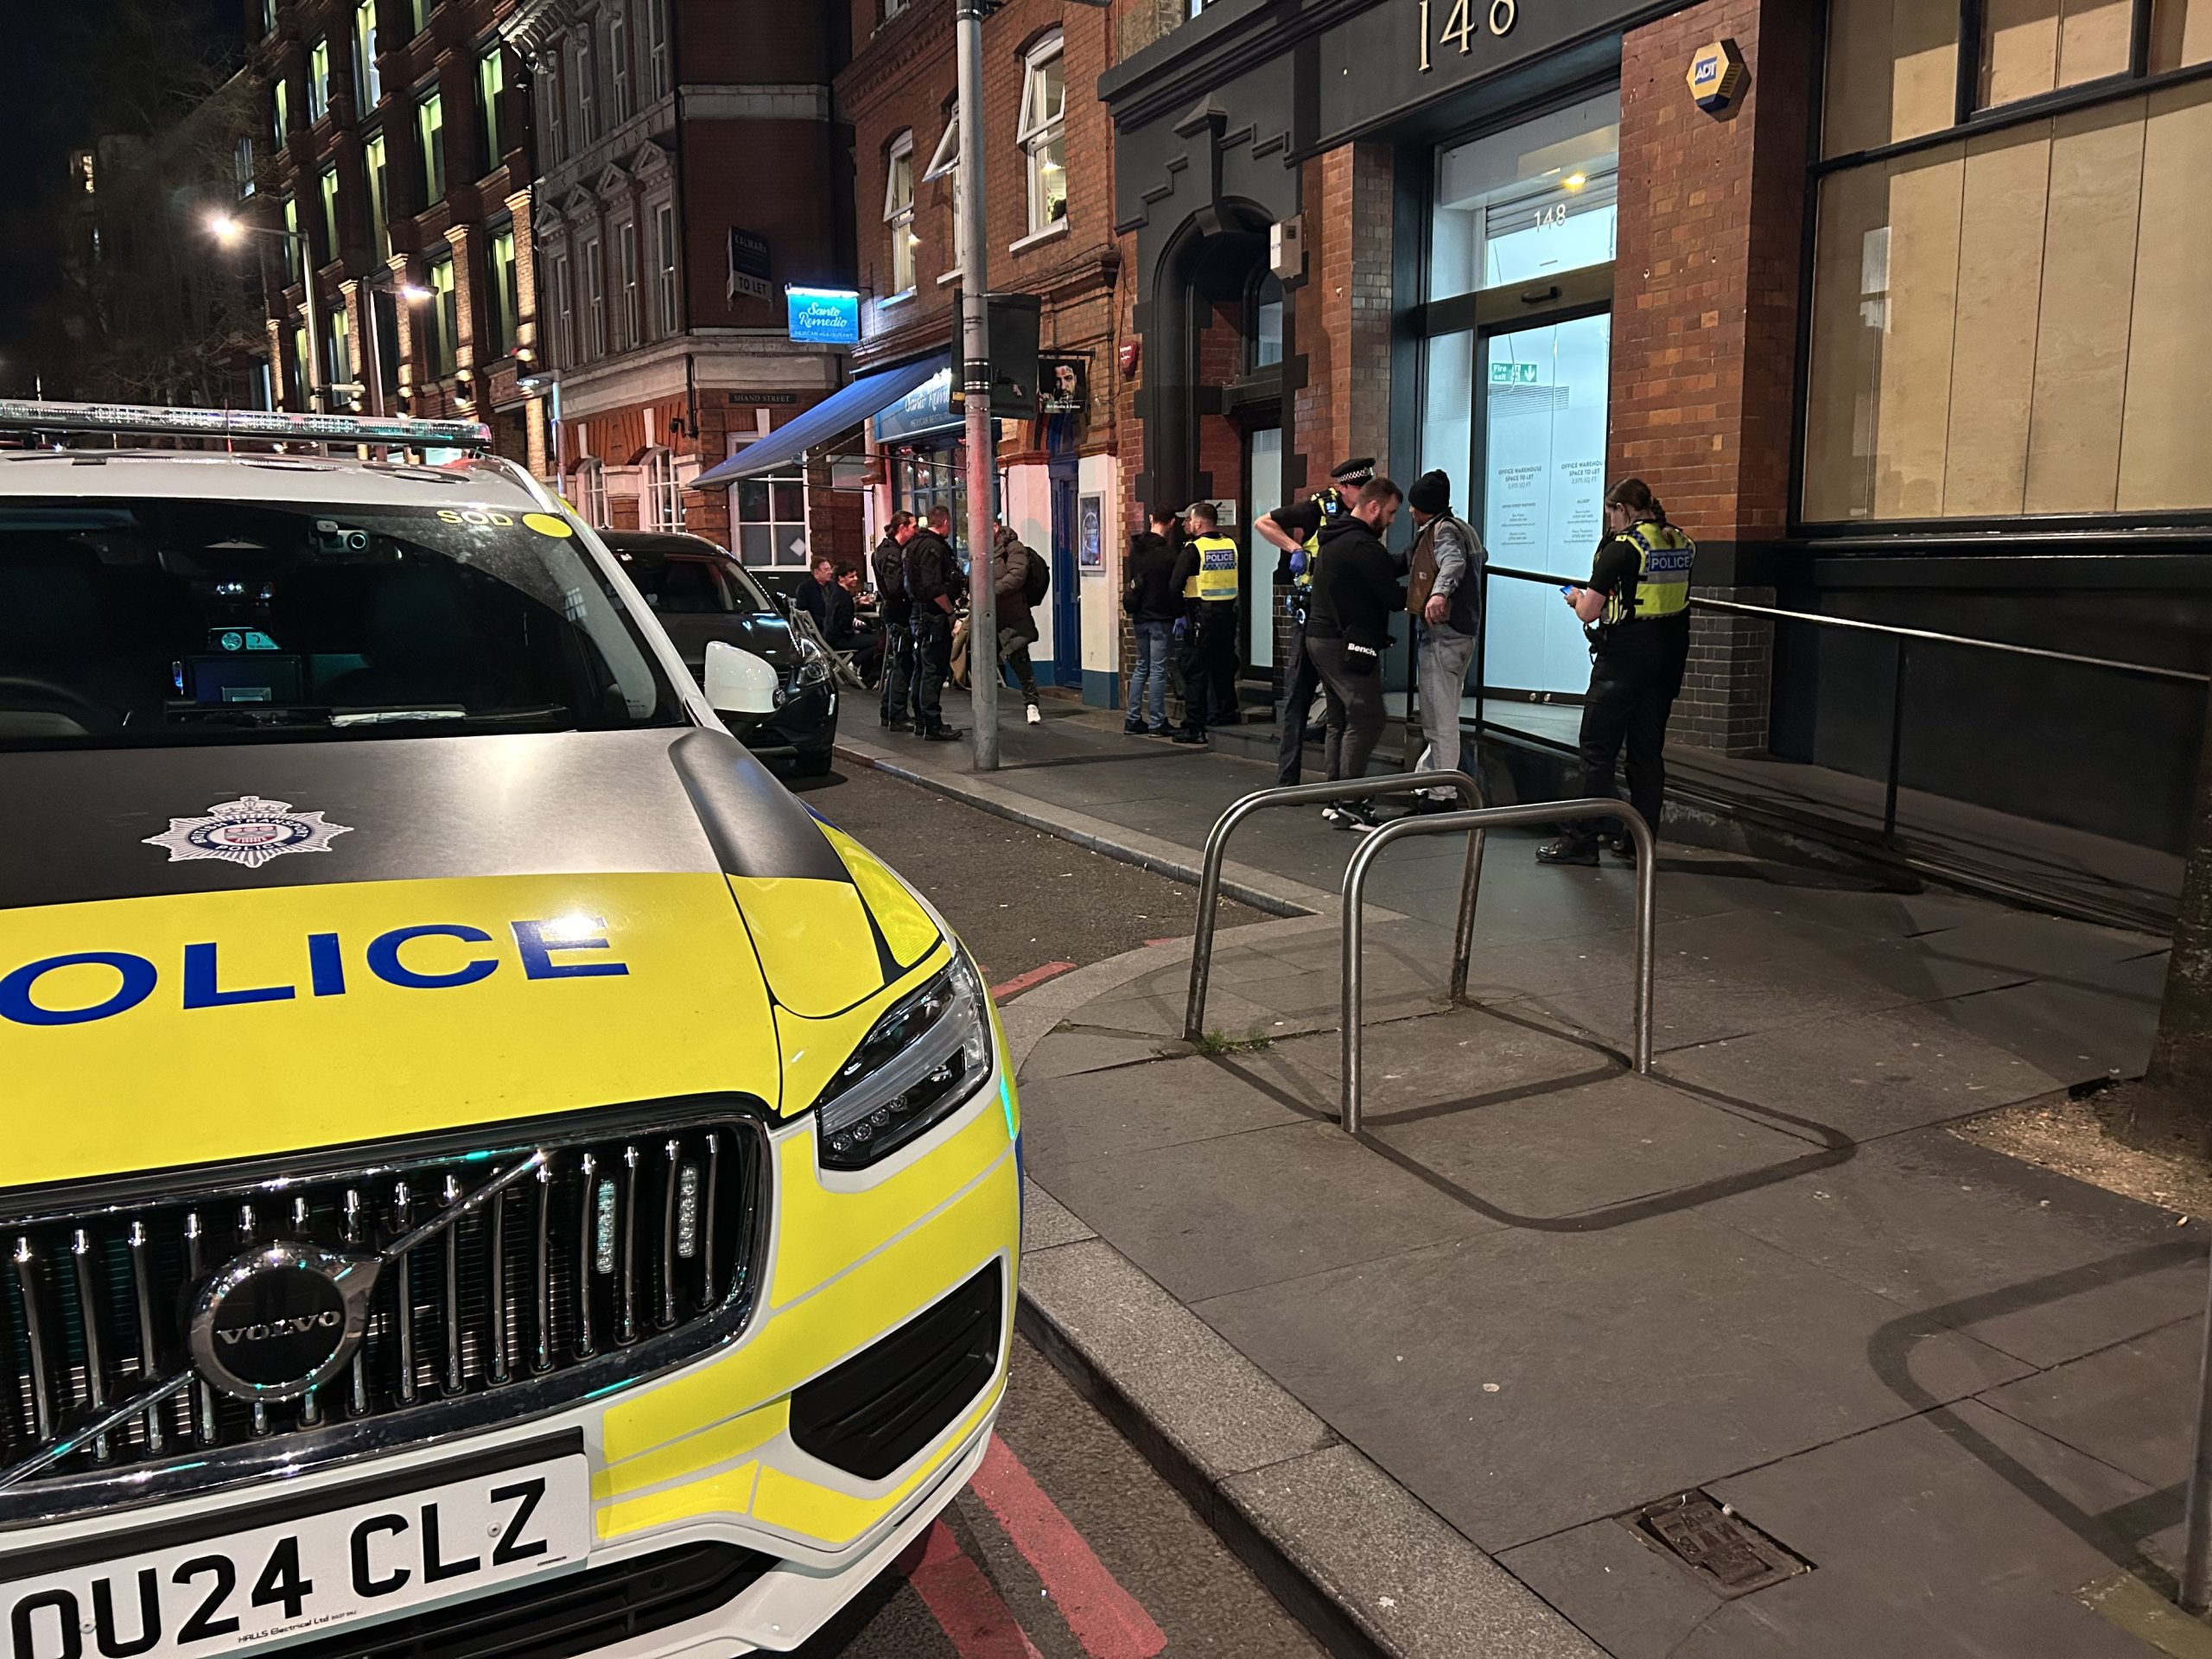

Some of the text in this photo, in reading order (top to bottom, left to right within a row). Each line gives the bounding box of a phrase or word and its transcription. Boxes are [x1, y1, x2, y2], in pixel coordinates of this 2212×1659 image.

[1694, 60, 1718, 81] ADT
[1535, 204, 1566, 232] 148
[739, 276, 766, 295] TO LET
[808, 302, 841, 317] Santo
[798, 312, 848, 328] Remedio
[1493, 364, 1507, 372] Fire
[436, 510, 514, 526] SOD
[1206, 554, 1234, 563] POLICE
[1651, 556, 1690, 569] POLICE
[190, 817, 309, 844] BRITISH TRANSPORT
[215, 841, 287, 851] POLICE
[0, 919, 631, 1026] OLICE
[216, 1311, 341, 1344] VOLVO
[10, 1477, 548, 1659] OU24 CLZ
[238, 1630, 268, 1643] HALLS
[270, 1620, 312, 1636] Electrical
[314, 1615, 329, 1625] Ltd
